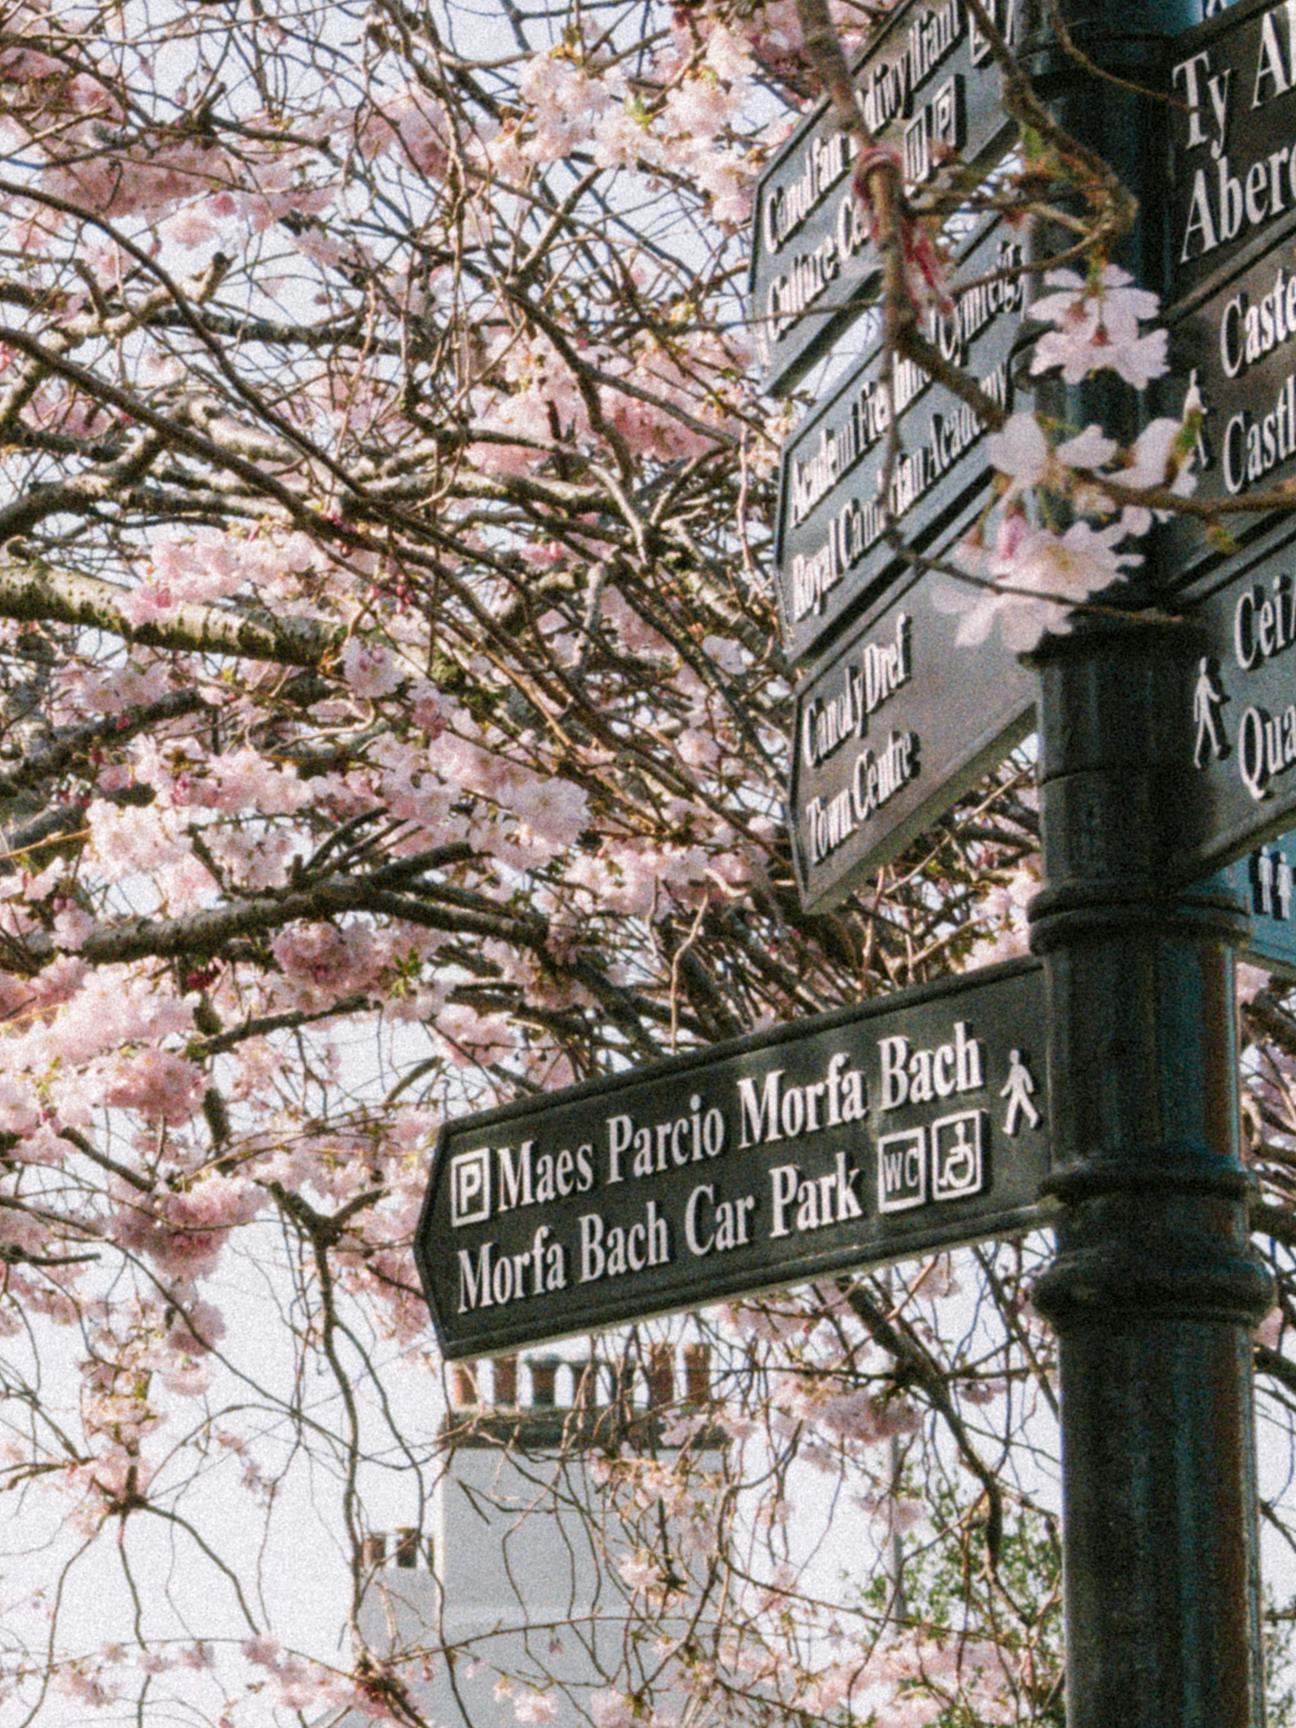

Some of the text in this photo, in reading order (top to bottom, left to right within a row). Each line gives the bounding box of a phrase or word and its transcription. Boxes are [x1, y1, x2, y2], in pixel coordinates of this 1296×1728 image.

[1173, 50, 1232, 160] Ty
[767, 235, 835, 342] Culture
[793, 518, 837, 622] Royal
[864, 612, 906, 713] Dref
[806, 730, 911, 864] Town Centre
[497, 1140, 594, 1212] Maes
[606, 1094, 725, 1184] Parcio
[737, 1052, 869, 1149] Morfa
[877, 1022, 983, 1111] Bach
[458, 1147, 919, 1313] Morfa Bach Car Park WC
